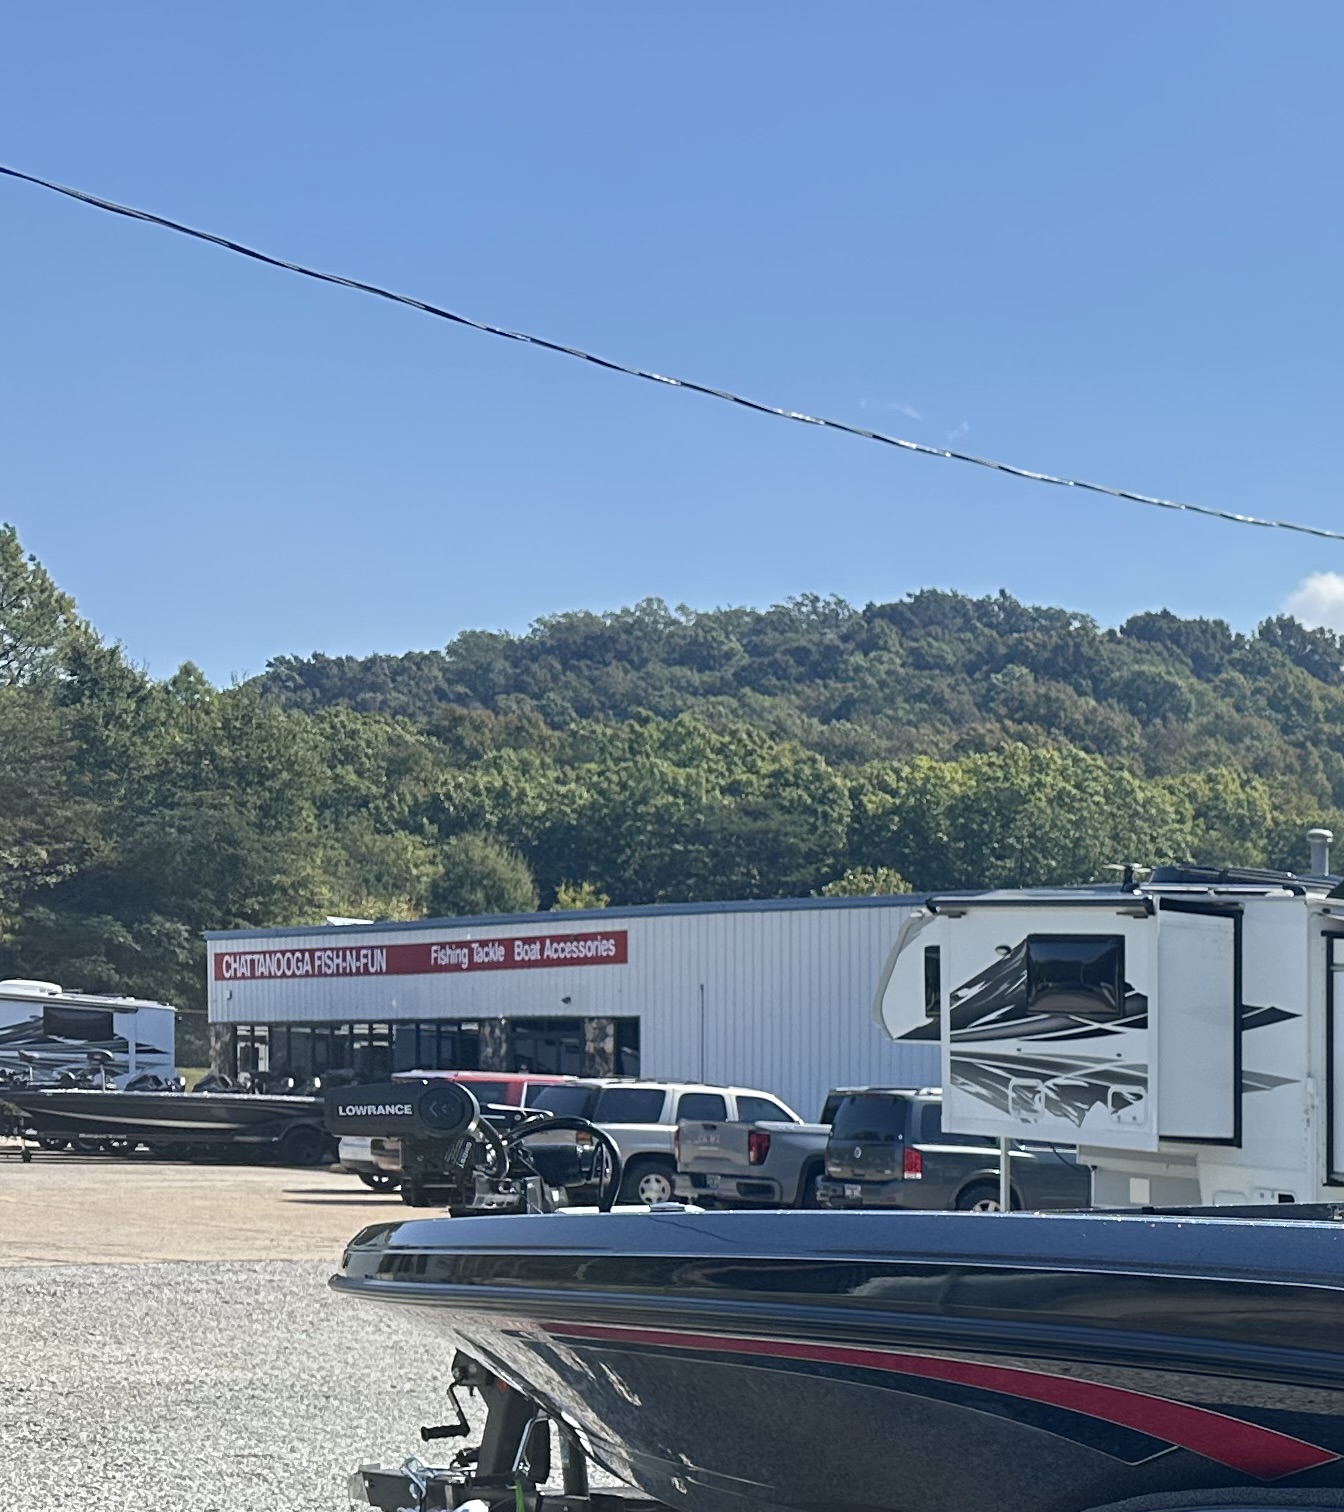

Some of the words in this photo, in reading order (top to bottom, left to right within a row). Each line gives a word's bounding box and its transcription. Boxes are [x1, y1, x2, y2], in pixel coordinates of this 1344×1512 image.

[222, 951, 312, 979] CHATTANOOGA
[314, 948, 387, 974] FISH-N-FUN
[430, 944, 469, 970] Fishing
[471, 941, 505, 963] Tackle
[514, 940, 541, 961] Boat
[543, 936, 616, 960] Accessories
[338, 1104, 413, 1117] LOWRANCE
